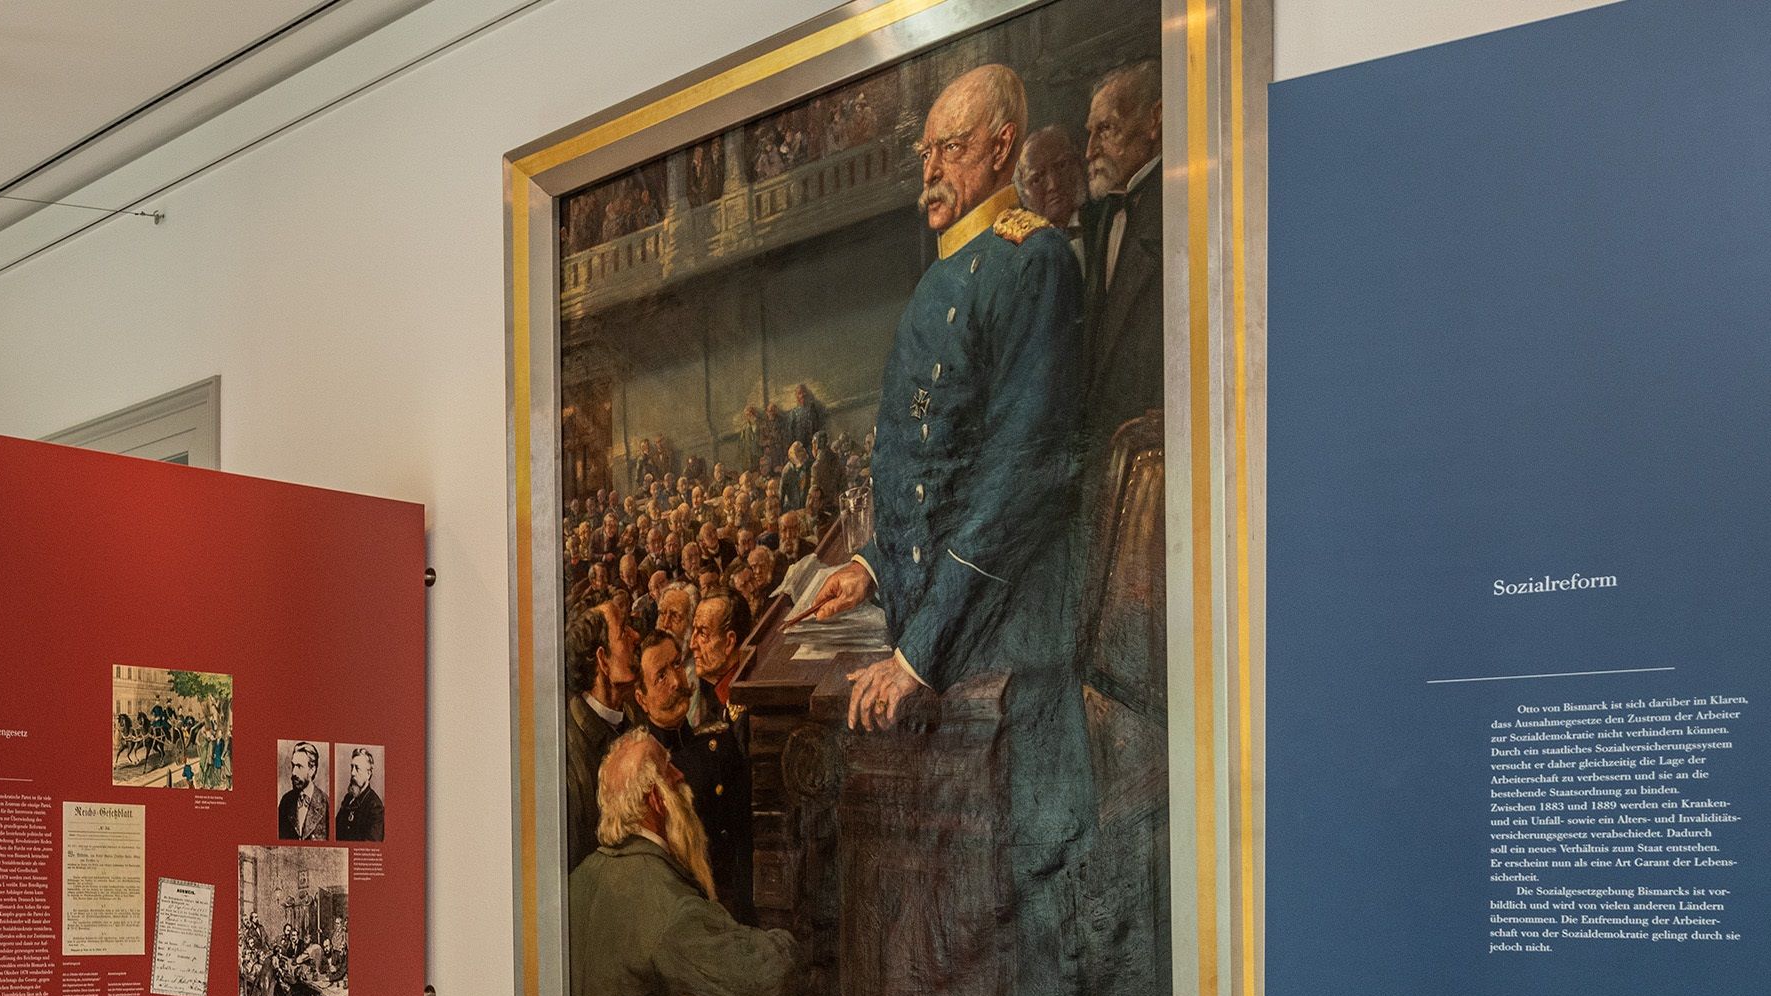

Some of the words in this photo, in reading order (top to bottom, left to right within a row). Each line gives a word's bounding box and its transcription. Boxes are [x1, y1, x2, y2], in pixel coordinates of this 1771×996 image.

[1493, 572, 1617, 596] Sozialreform
[1516, 704, 1540, 714] Otto
[1562, 700, 1608, 712] Bismarck
[1610, 700, 1623, 709] ist
[1625, 698, 1646, 708] sich
[1648, 697, 1691, 708] darüber
[1692, 696, 1707, 706] im
[1709, 694, 1749, 704] Klaren,
[1490, 719, 1512, 729] dass
[1514, 717, 1602, 728] Ausnahmegesetze
[1604, 714, 1625, 724] den
[1626, 713, 1671, 723] Zustrom
[1674, 711, 1693, 721] der
[1695, 709, 1741, 720] Arbeiter
[1490, 735, 1508, 743] zur
[1509, 730, 1595, 742] Sozialdemokratie
[1597, 728, 1623, 738] nicht
[1625, 726, 1683, 737] verhindern
[1686, 725, 1729, 735] können.
[1490, 746, 1521, 756] Durch
[1522, 746, 1539, 756] ein
[1541, 744, 1593, 755] staatliches
[1594, 741, 1733, 753] Sozialversicherungssystem
[1490, 760, 1532, 770] versucht
[1546, 758, 1577, 769] daher
[1578, 756, 1637, 770] gleichzeitig
[1638, 756, 1656, 766] die
[1658, 755, 1685, 767] Lage
[1687, 754, 1707, 764] der
[1490, 773, 1559, 784] Arbeiterschaft
[1576, 772, 1632, 782] verbessern
[1634, 770, 1656, 780] und
[1658, 770, 1673, 780] sie
[1691, 769, 1709, 779] die
[1490, 787, 1547, 798] bestehende
[1548, 786, 1622, 798] Staatsordnung
[1640, 784, 1680, 794] binden.
[1490, 802, 1536, 812] Zwischen
[1539, 801, 1564, 811] 1883
[1567, 800, 1588, 810] und
[1591, 800, 1617, 810] 1889
[1619, 799, 1659, 809] werden
[1660, 799, 1678, 808] ein
[1680, 798, 1731, 808] Kranken-
[1490, 816, 1510, 826] und
[1512, 816, 1528, 826] ein
[1530, 815, 1564, 826] Unfall-
[1566, 815, 1596, 824] sowie
[1597, 814, 1614, 824] ein
[1616, 814, 1651, 824] Alters-
[1653, 813, 1676, 823] und
[1678, 812, 1741, 823] Invaliditäts-
[1489, 830, 1588, 842] versicherungsgesetz
[1589, 828, 1663, 839] verabschiedet.
[1666, 827, 1712, 838] Dadurch
[1490, 844, 1508, 854] soll
[1509, 844, 1526, 854] ein
[1559, 843, 1610, 853] Verhältnis
[1636, 842, 1663, 852] Staat
[1665, 842, 1720, 852] entstehen.
[1490, 858, 1503, 868] Er
[1503, 858, 1549, 868] erscheint
[1573, 857, 1588, 867] als
[1589, 858, 1612, 867] eine
[1614, 857, 1631, 867] Art
[1633, 857, 1670, 867] Garant
[1672, 856, 1692, 867] der
[1693, 856, 1738, 866] Lebens-
[1489, 872, 1540, 882] sicherheit.
[1516, 886, 1534, 896] Die
[1535, 886, 1635, 898] Sozialgesetzgebung
[1637, 886, 1690, 896] Bismarcks
[1692, 886, 1706, 896] ist
[1708, 888, 1731, 896] vor-
[1489, 899, 1527, 909] bildlich
[1529, 900, 1550, 910] und
[1551, 900, 1575, 910] wird
[1599, 900, 1630, 910] vielen
[1632, 900, 1676, 910] anderen
[1678, 900, 1724, 910] Ländern
[1489, 913, 1558, 924] übernommen.
[1560, 914, 1578, 924] Die
[1580, 914, 1649, 927] Entfremdung
[1651, 915, 1670, 925] der
[1671, 915, 1721, 925] Arbeiter-
[1489, 927, 1518, 937] schaft
[1541, 928, 1560, 938] der
[1561, 928, 1649, 939] Sozialdemokratie
[1651, 929, 1688, 942] gelingt
[1690, 930, 1723, 940] durch
[1725, 930, 1741, 940] sie
[1488, 941, 1523, 954] jedoch
[1525, 942, 1553, 952] nicht.
